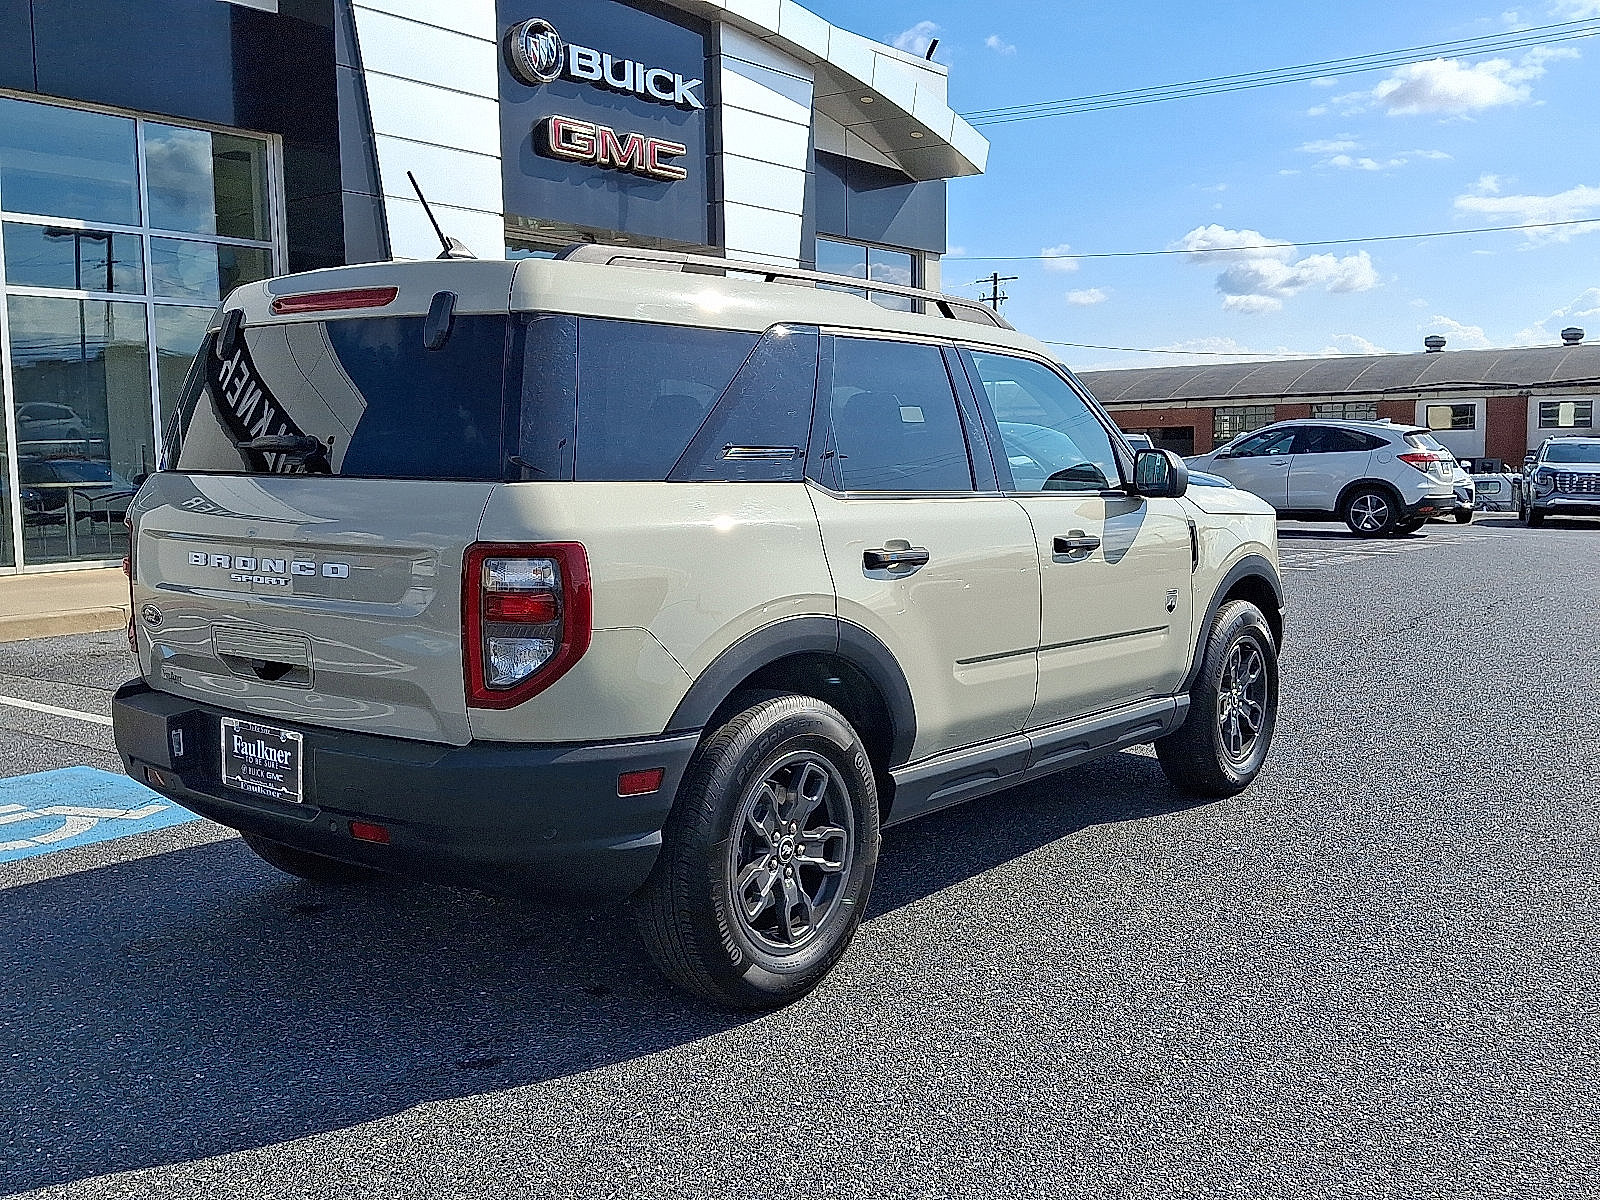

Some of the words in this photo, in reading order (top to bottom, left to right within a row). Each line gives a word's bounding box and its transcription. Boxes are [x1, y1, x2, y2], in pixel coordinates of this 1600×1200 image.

[568, 43, 705, 110] BUICK
[550, 114, 688, 180] GMC
[188, 551, 349, 579] BRONCO
[230, 574, 292, 586] SPORT
[233, 734, 291, 764] Faulkner
[245, 755, 254, 764] TO
[255, 757, 262, 766] BE
[264, 759, 279, 770] SURE
[248, 766, 265, 778] BUICK
[266, 771, 284, 782] GMC
[240, 781, 282, 798] Faulkner
